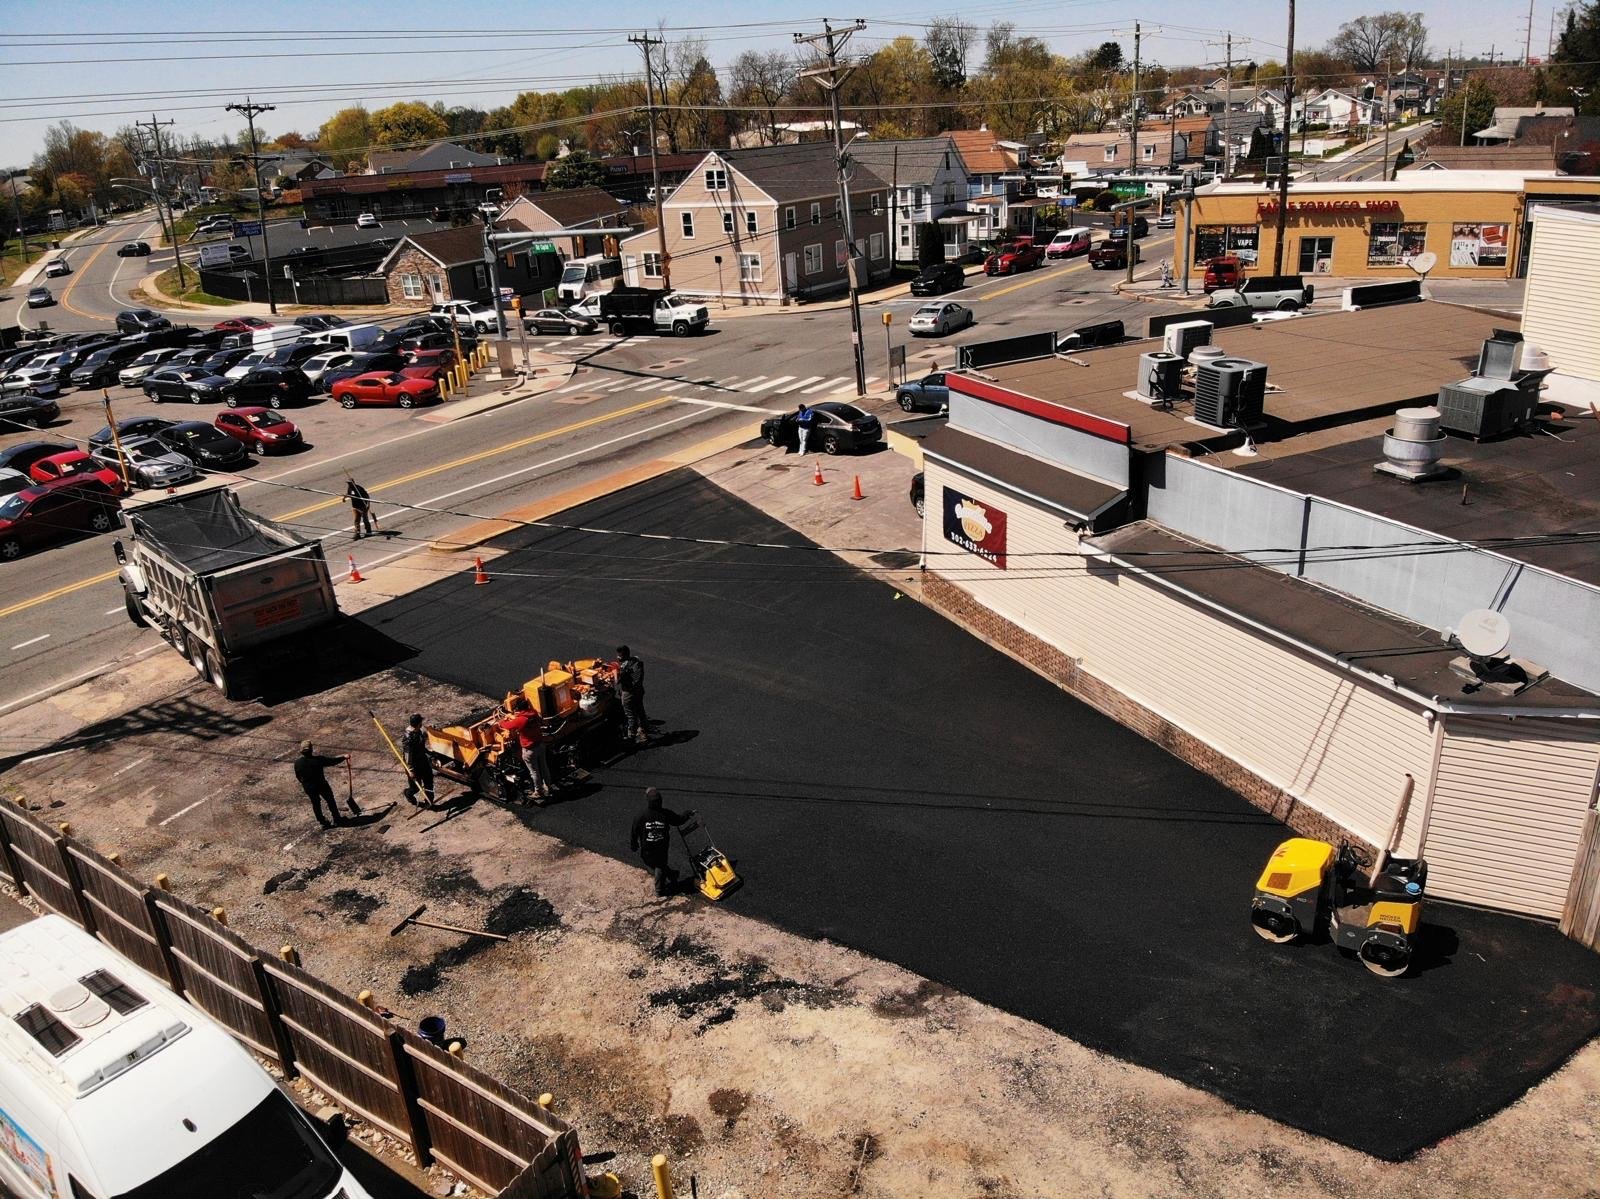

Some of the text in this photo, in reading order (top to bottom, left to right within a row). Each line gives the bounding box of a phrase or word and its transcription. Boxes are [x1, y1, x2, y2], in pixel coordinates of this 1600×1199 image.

[1258, 200, 1400, 214] EAGE TOBACCO SHOP
